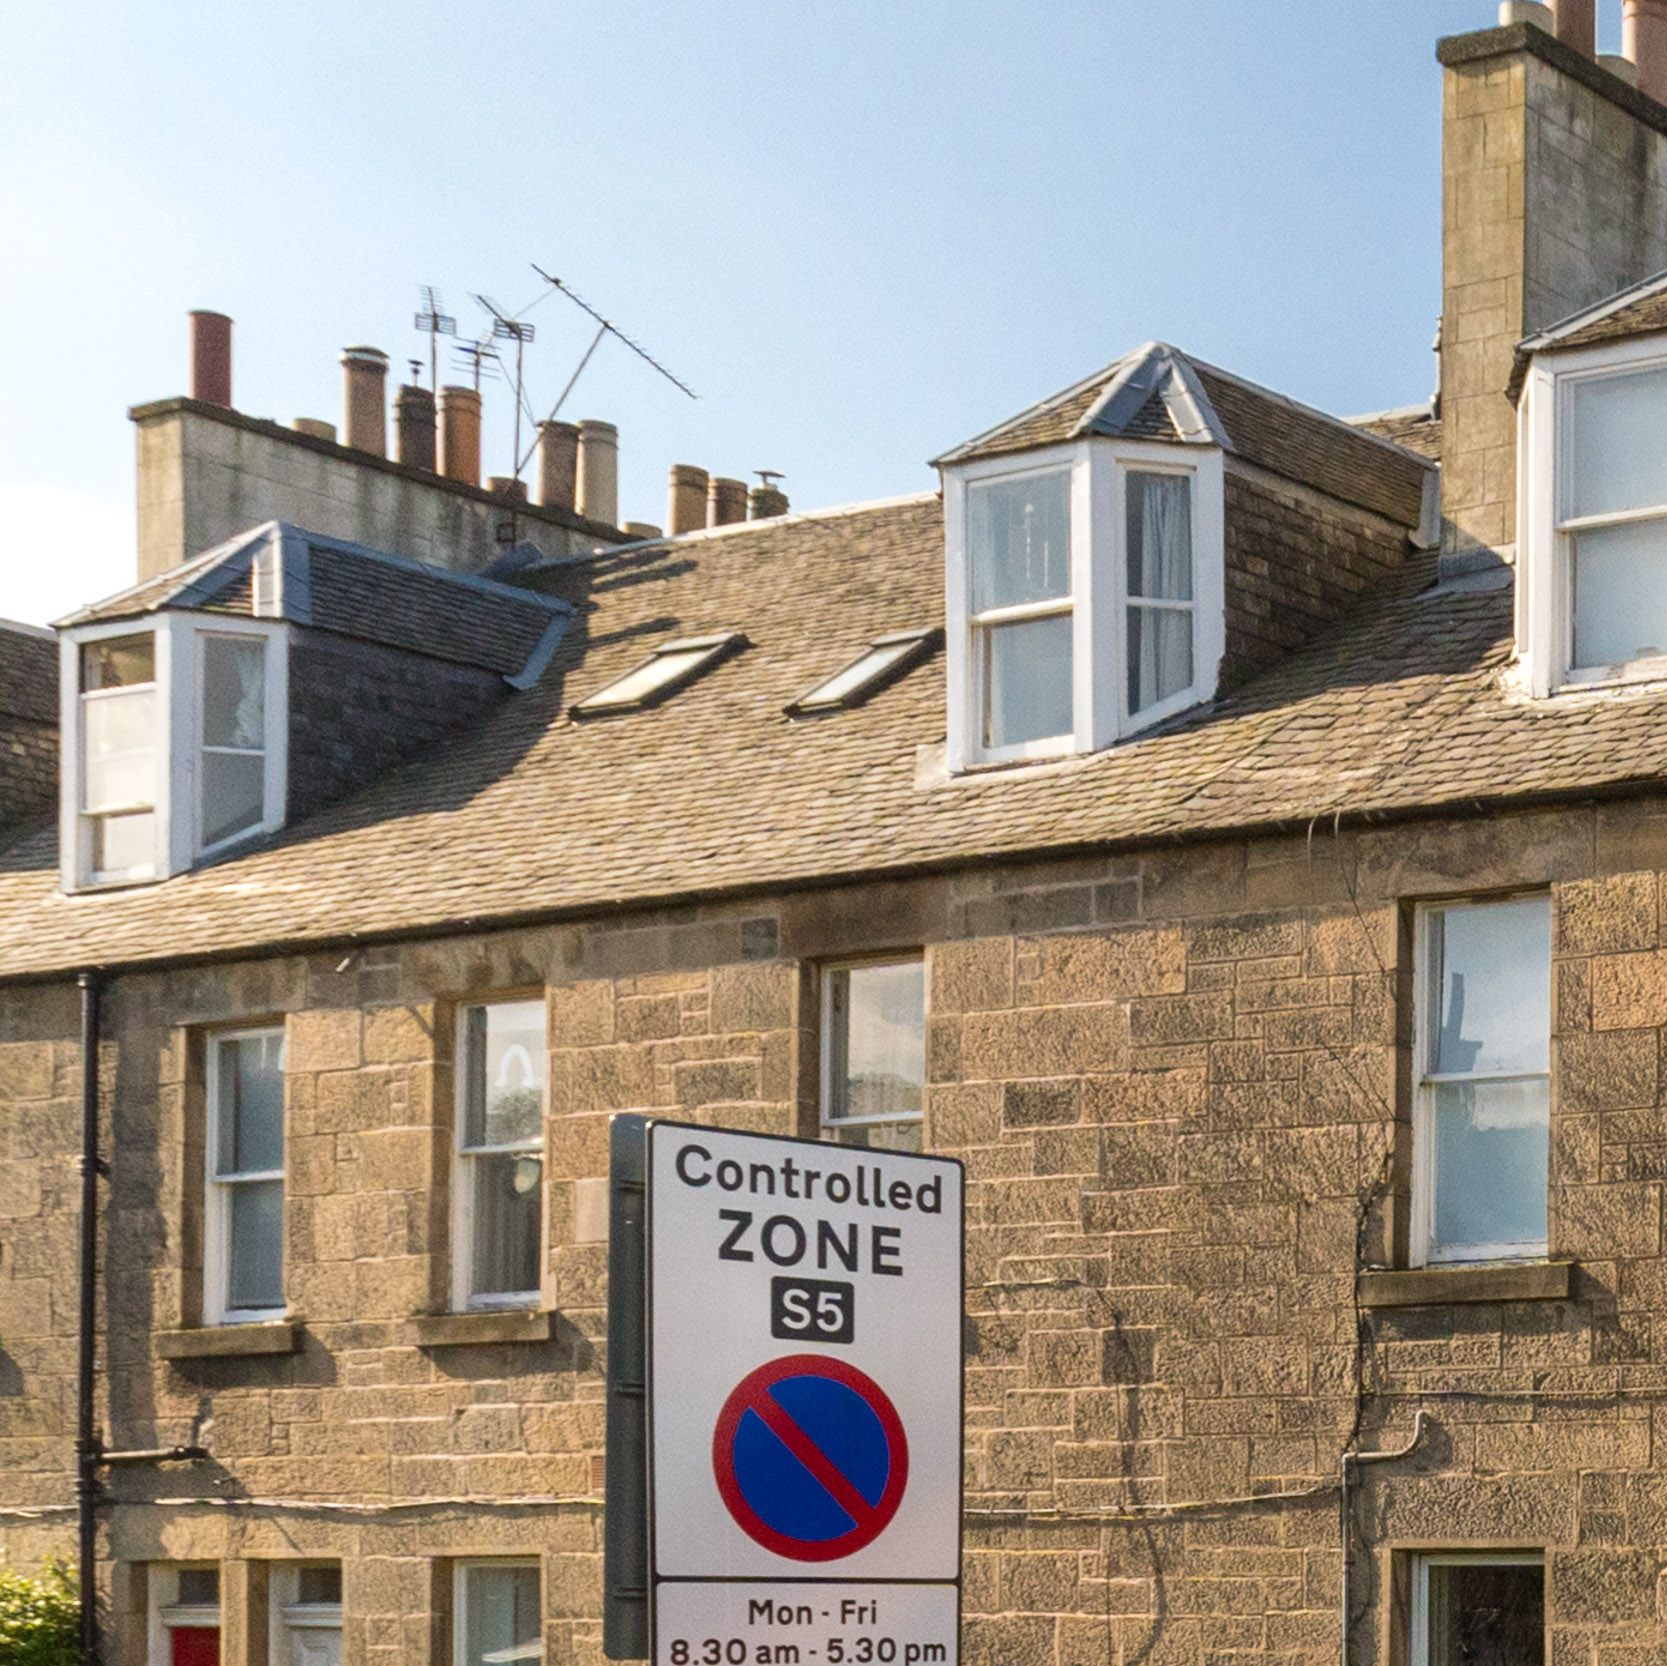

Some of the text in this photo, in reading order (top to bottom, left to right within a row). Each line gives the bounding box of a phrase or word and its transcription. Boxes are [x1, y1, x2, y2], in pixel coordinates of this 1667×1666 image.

[675, 1144, 942, 1214] Controlled
[718, 1209, 904, 1276] ZONE
[781, 1289, 844, 1333] S5
[748, 1600, 813, 1626] Mon
[840, 1599, 877, 1625] Fri
[670, 1638, 747, 1666] 8.30
[755, 1644, 800, 1665] am
[827, 1637, 896, 1664] 5.30
[904, 1642, 946, 1666] pm
